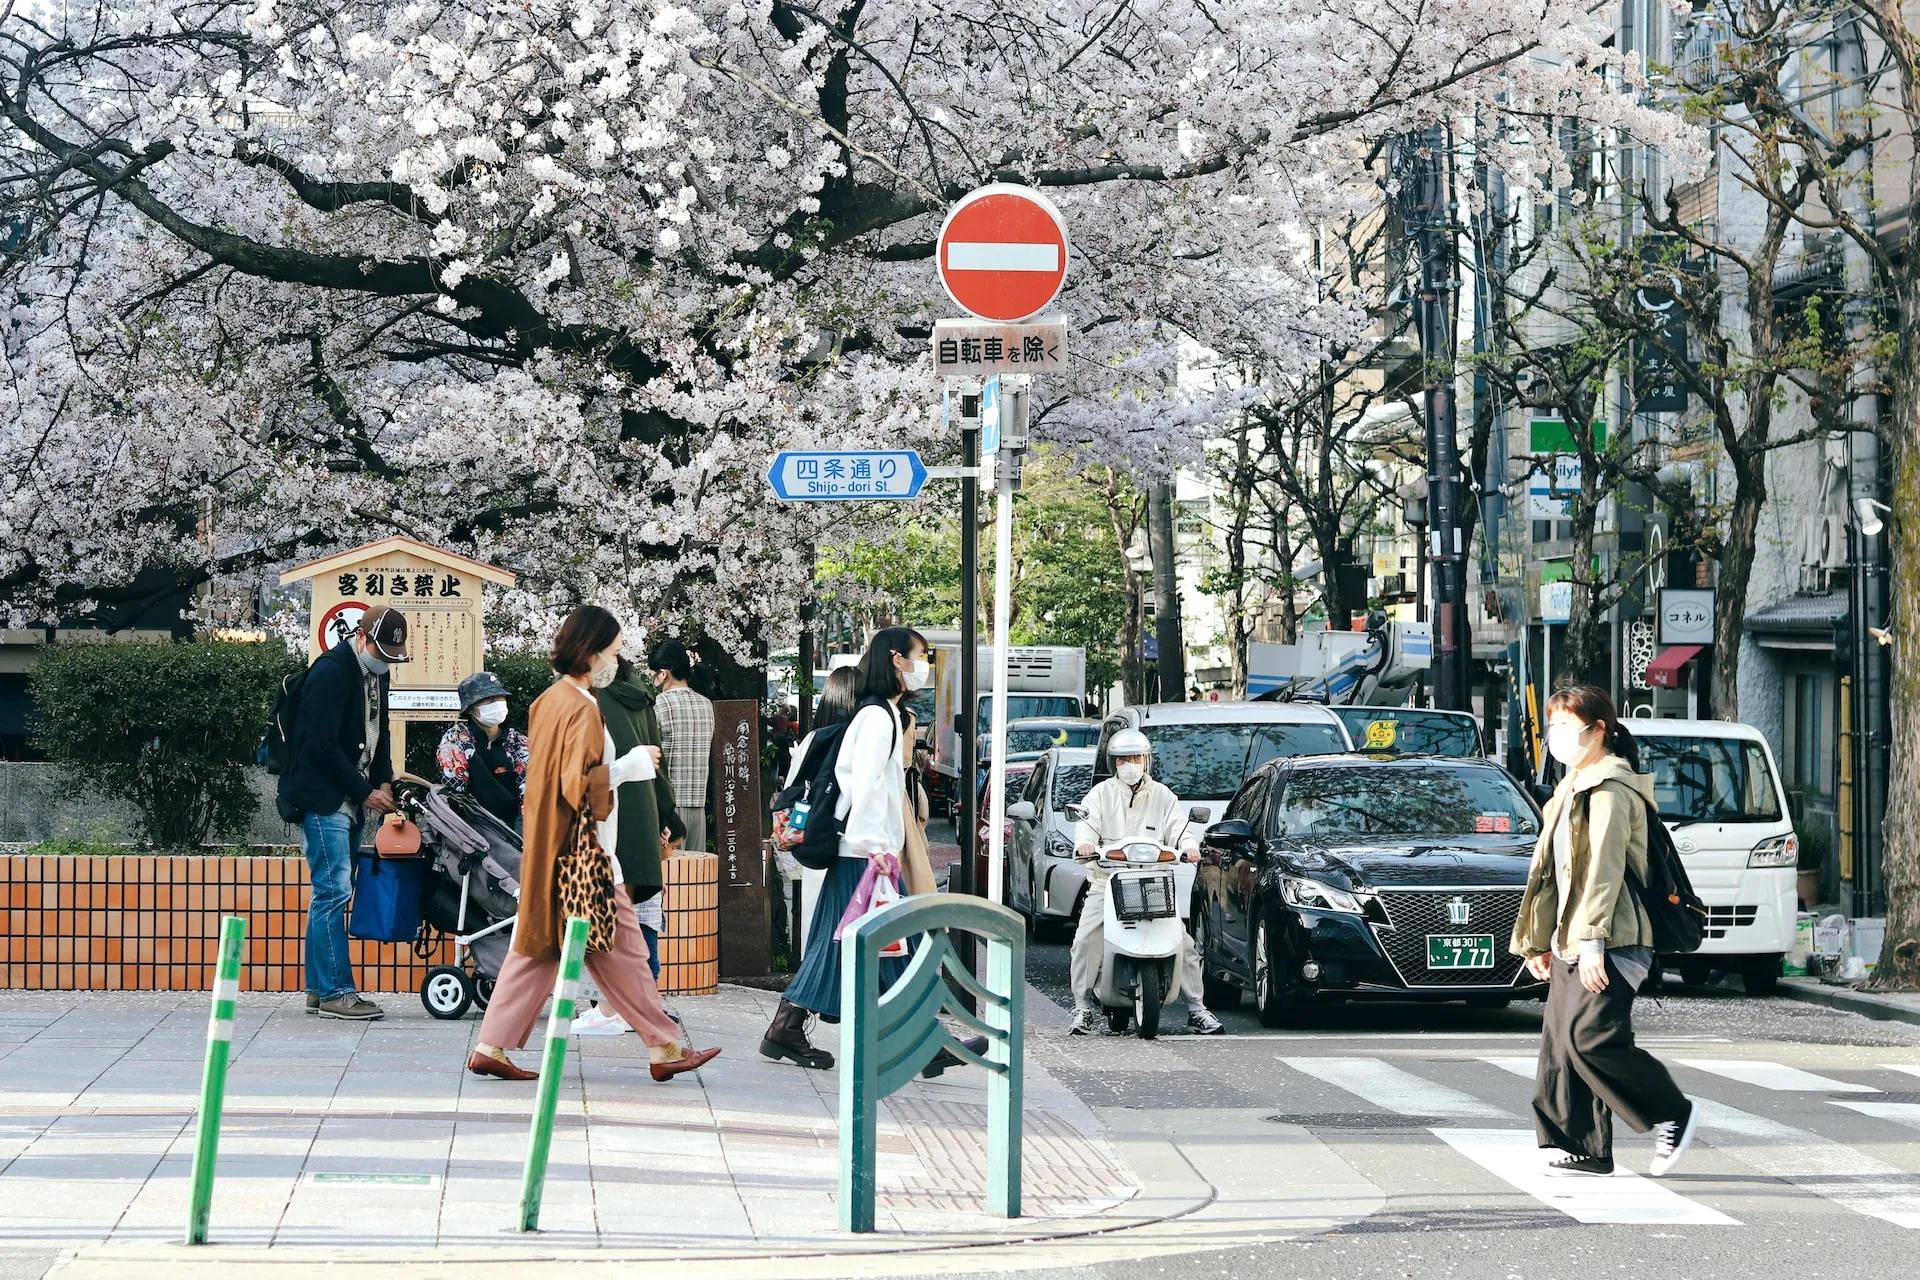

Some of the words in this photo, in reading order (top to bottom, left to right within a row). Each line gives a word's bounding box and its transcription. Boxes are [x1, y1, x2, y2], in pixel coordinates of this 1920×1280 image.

[939, 336, 1059, 364] 自転車を除く
[796, 459, 897, 480] 四条通り
[808, 481, 871, 494] Shijo-dori
[875, 481, 891, 493] St.
[338, 573, 461, 597] 客引き禁止
[1669, 610, 1706, 624] コネル
[1442, 937, 1478, 948] 京都301
